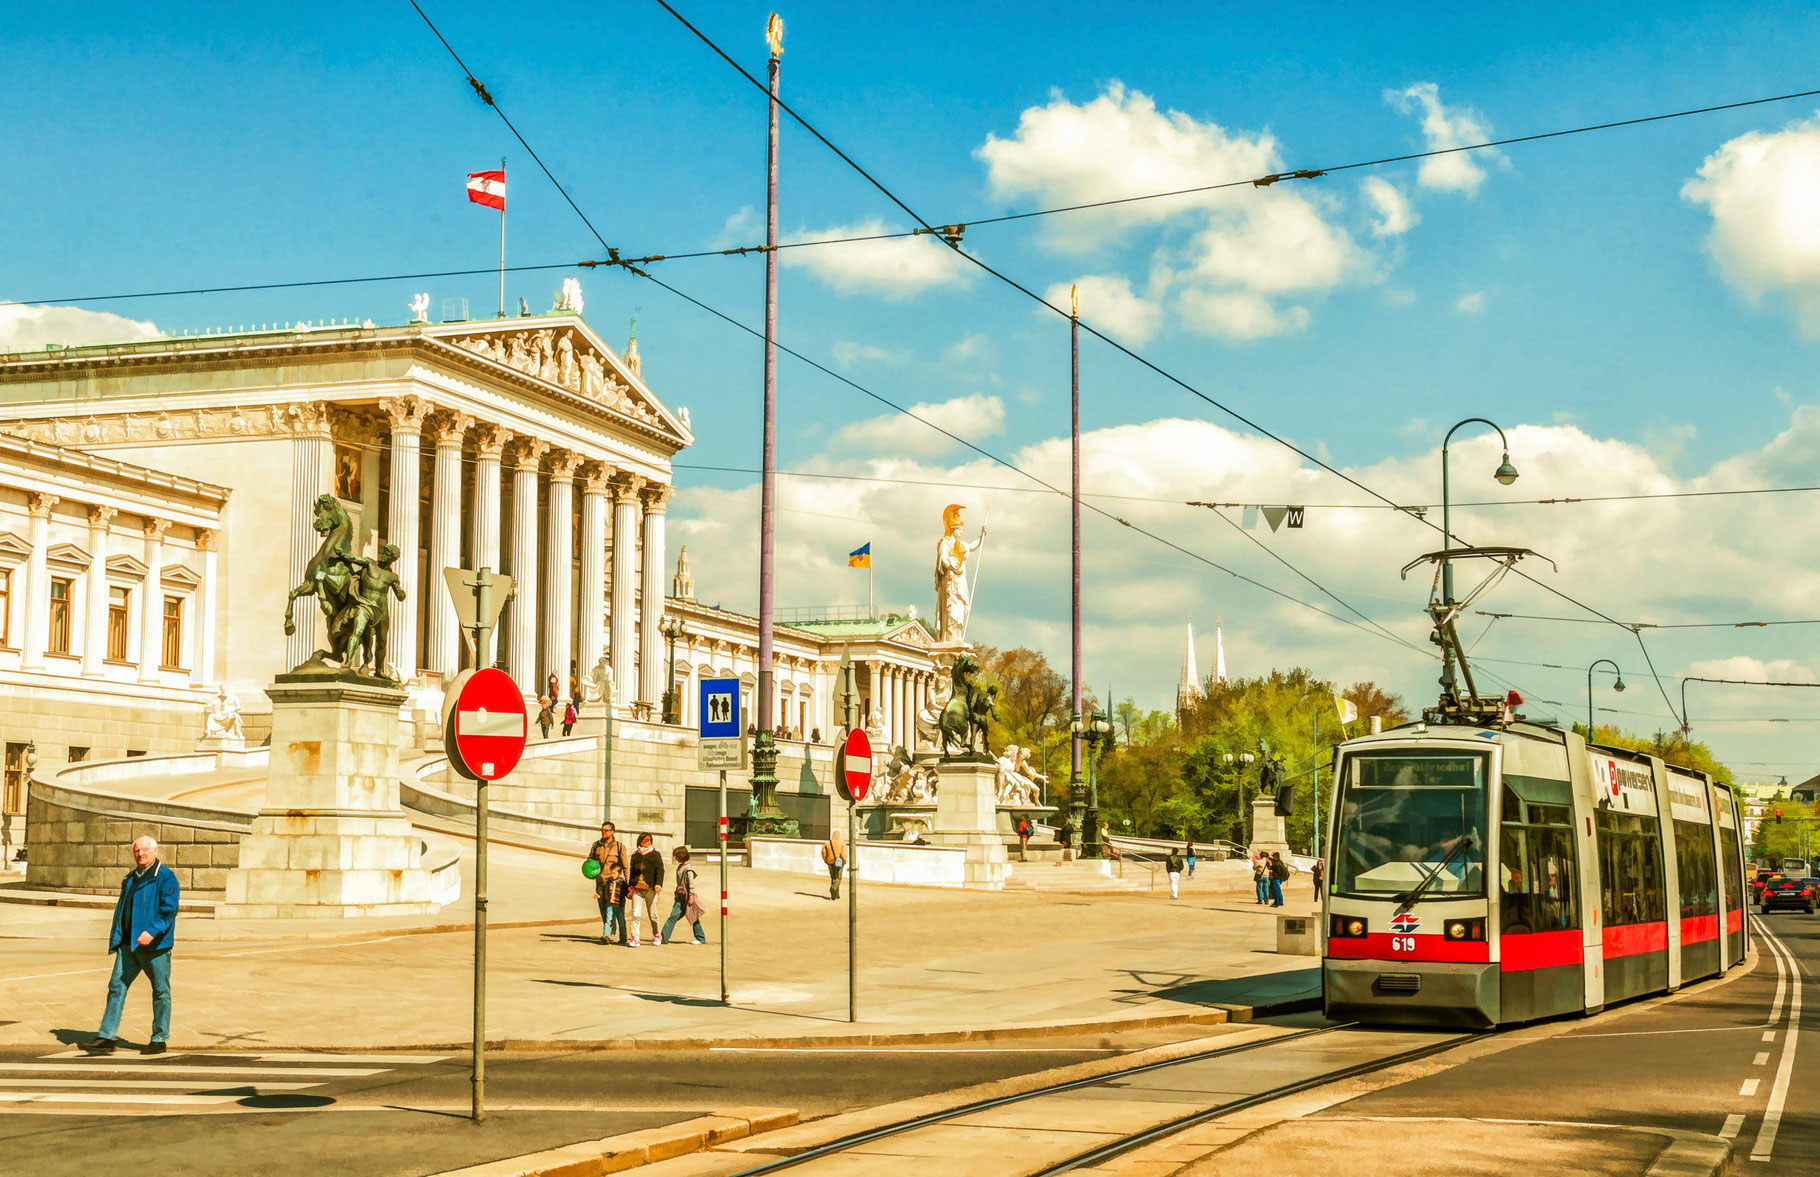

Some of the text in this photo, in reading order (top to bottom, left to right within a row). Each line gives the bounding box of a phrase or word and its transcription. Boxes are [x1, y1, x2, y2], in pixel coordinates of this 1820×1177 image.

[1290, 511, 1303, 525] W
[1383, 761, 1470, 772] Zenalfriedhof
[1424, 773, 1442, 784] Tor
[1392, 937, 1415, 951] 619
